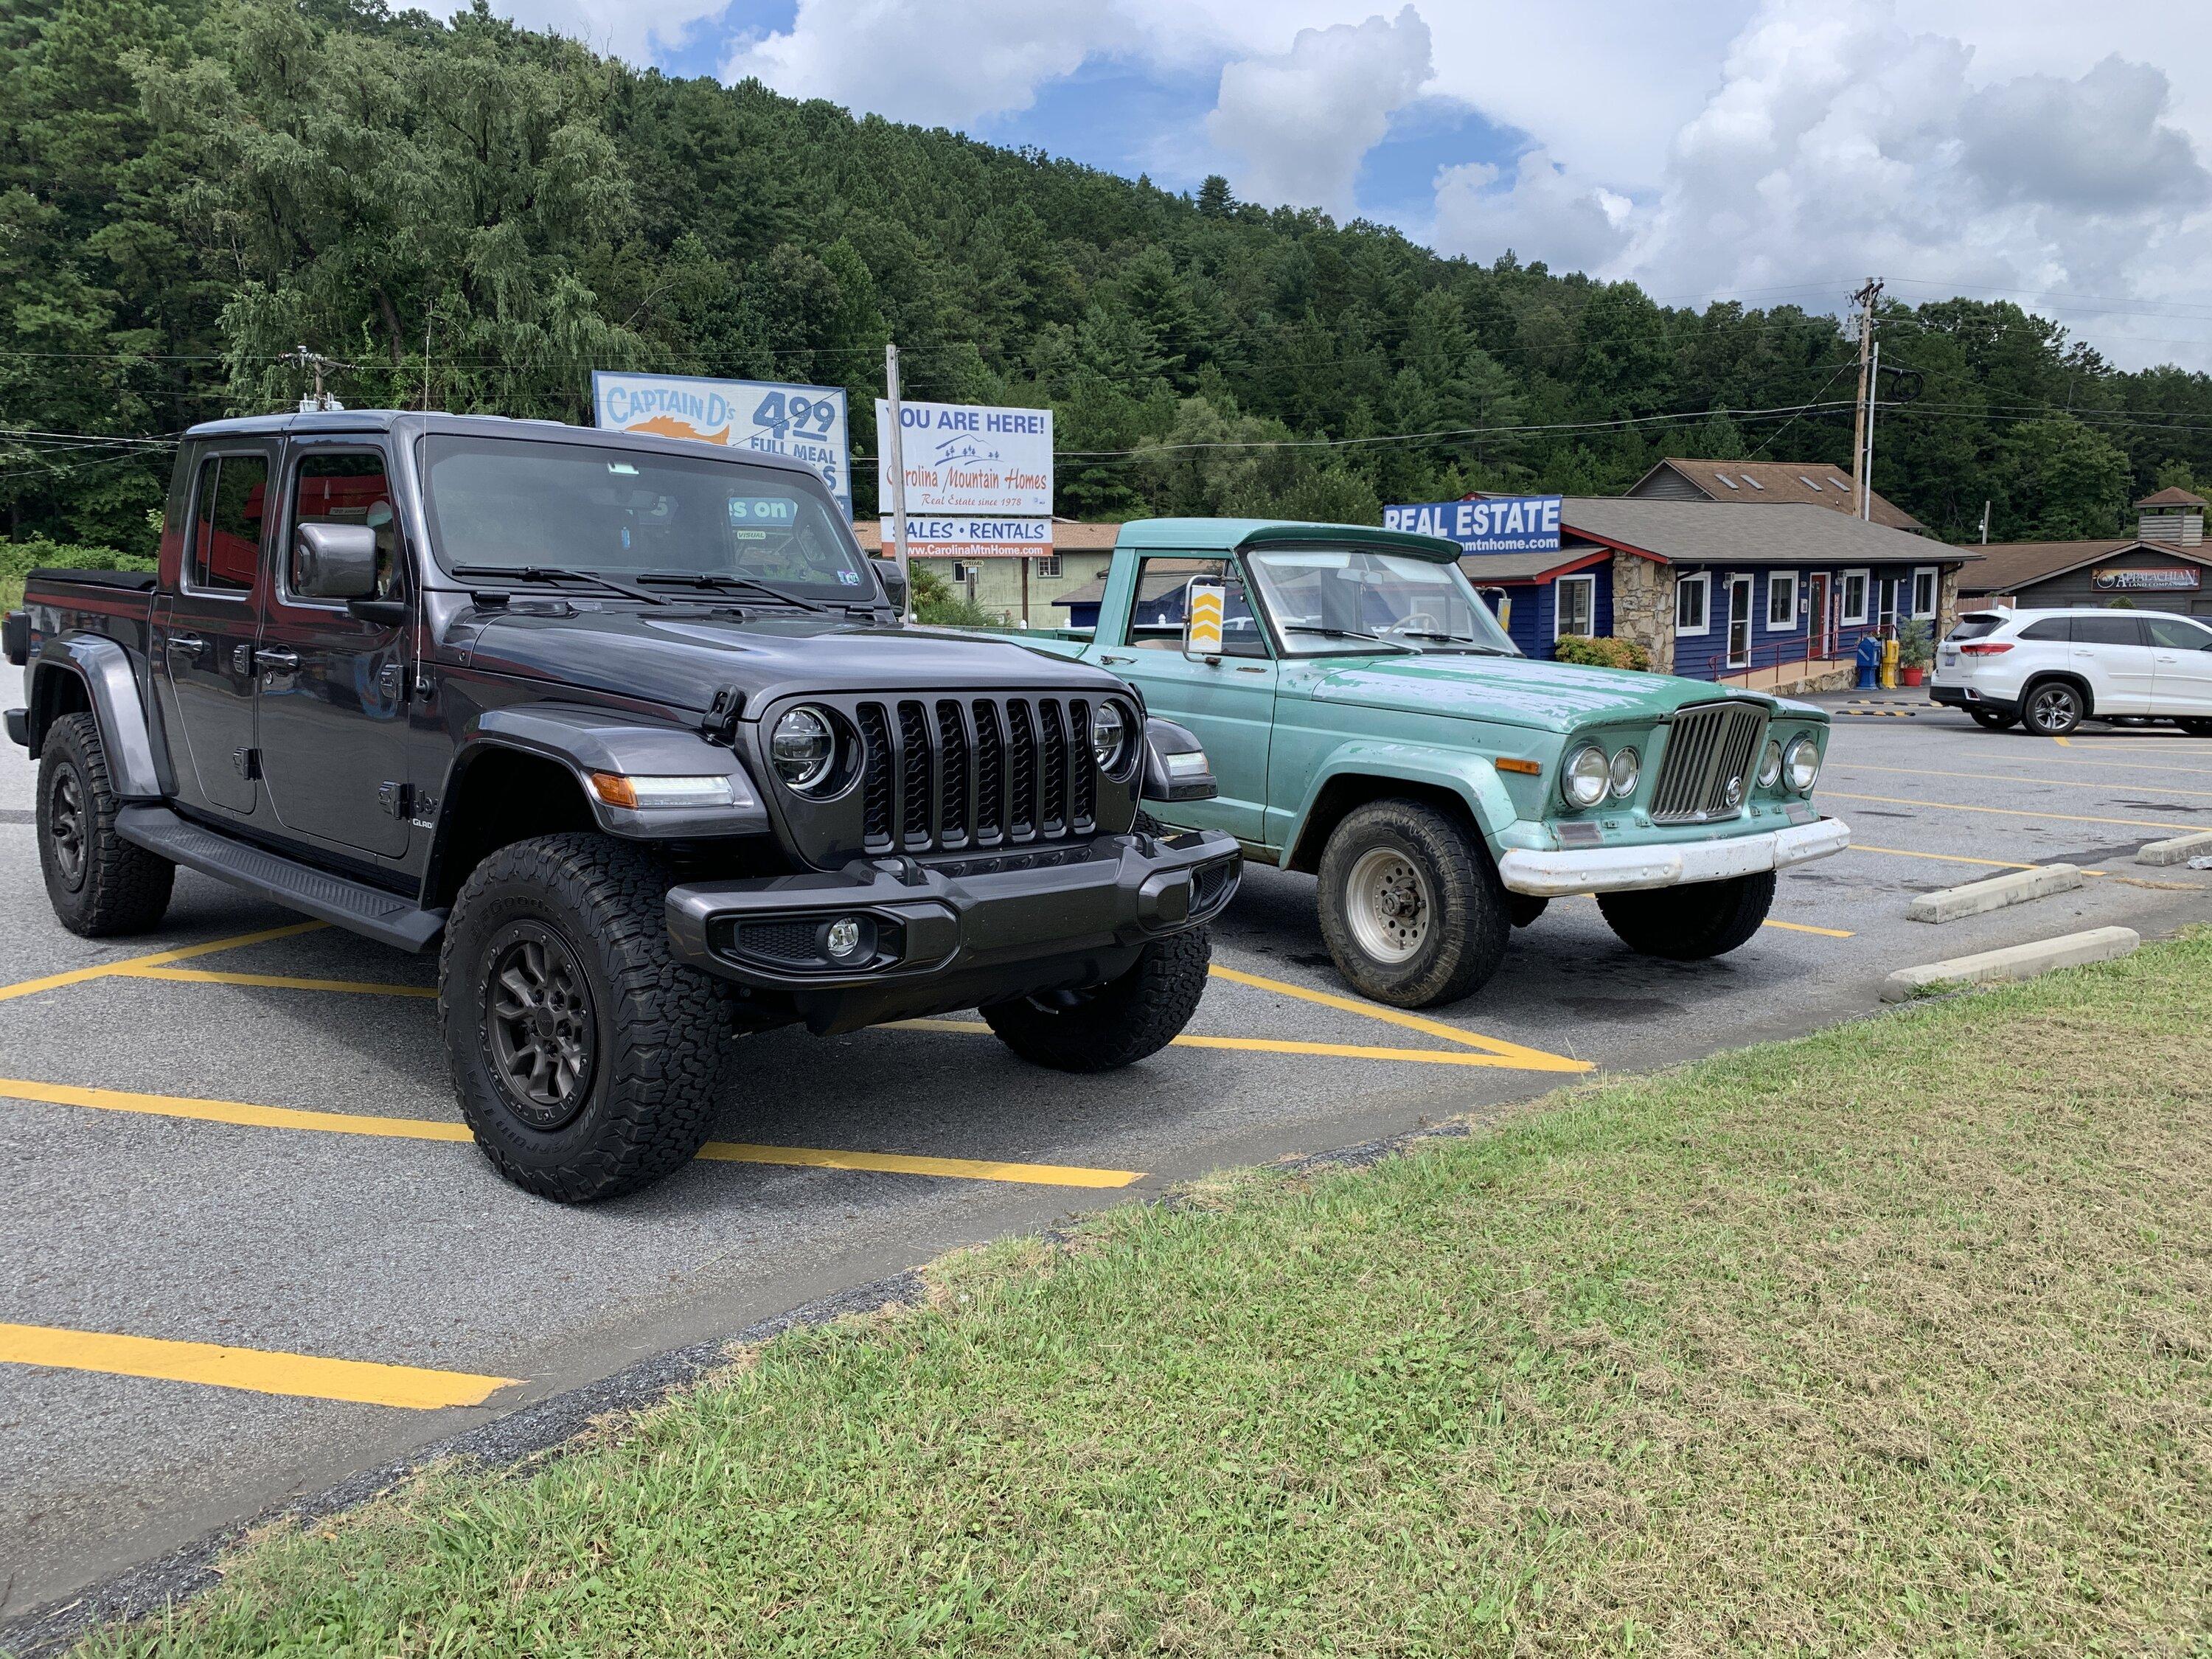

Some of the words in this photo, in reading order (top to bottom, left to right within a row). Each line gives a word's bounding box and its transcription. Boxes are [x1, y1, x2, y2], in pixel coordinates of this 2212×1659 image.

[607, 386, 703, 423] CAPTAIN
[886, 407, 931, 428] OU
[937, 411, 979, 431] ARE
[987, 414, 1044, 434] HERE!
[751, 437, 787, 455] FULL
[794, 444, 837, 465] MEAL
[887, 465, 938, 487] Crolina
[942, 466, 999, 493] Mountain
[1004, 468, 1046, 490] Homes
[922, 494, 945, 507] Real
[948, 492, 975, 506] Estate
[978, 495, 998, 507] since
[1001, 498, 1022, 507] 1978
[754, 501, 787, 518] on
[1385, 507, 1448, 538] REAL
[1456, 500, 1560, 537] ESTATE
[893, 521, 953, 539] ALES
[970, 522, 1044, 539] RENTALS
[894, 544, 1043, 556] ww.CarolinaMtnHome.com
[2116, 569, 2197, 588] APPALACHIAN
[412, 818, 434, 829] GLAD
